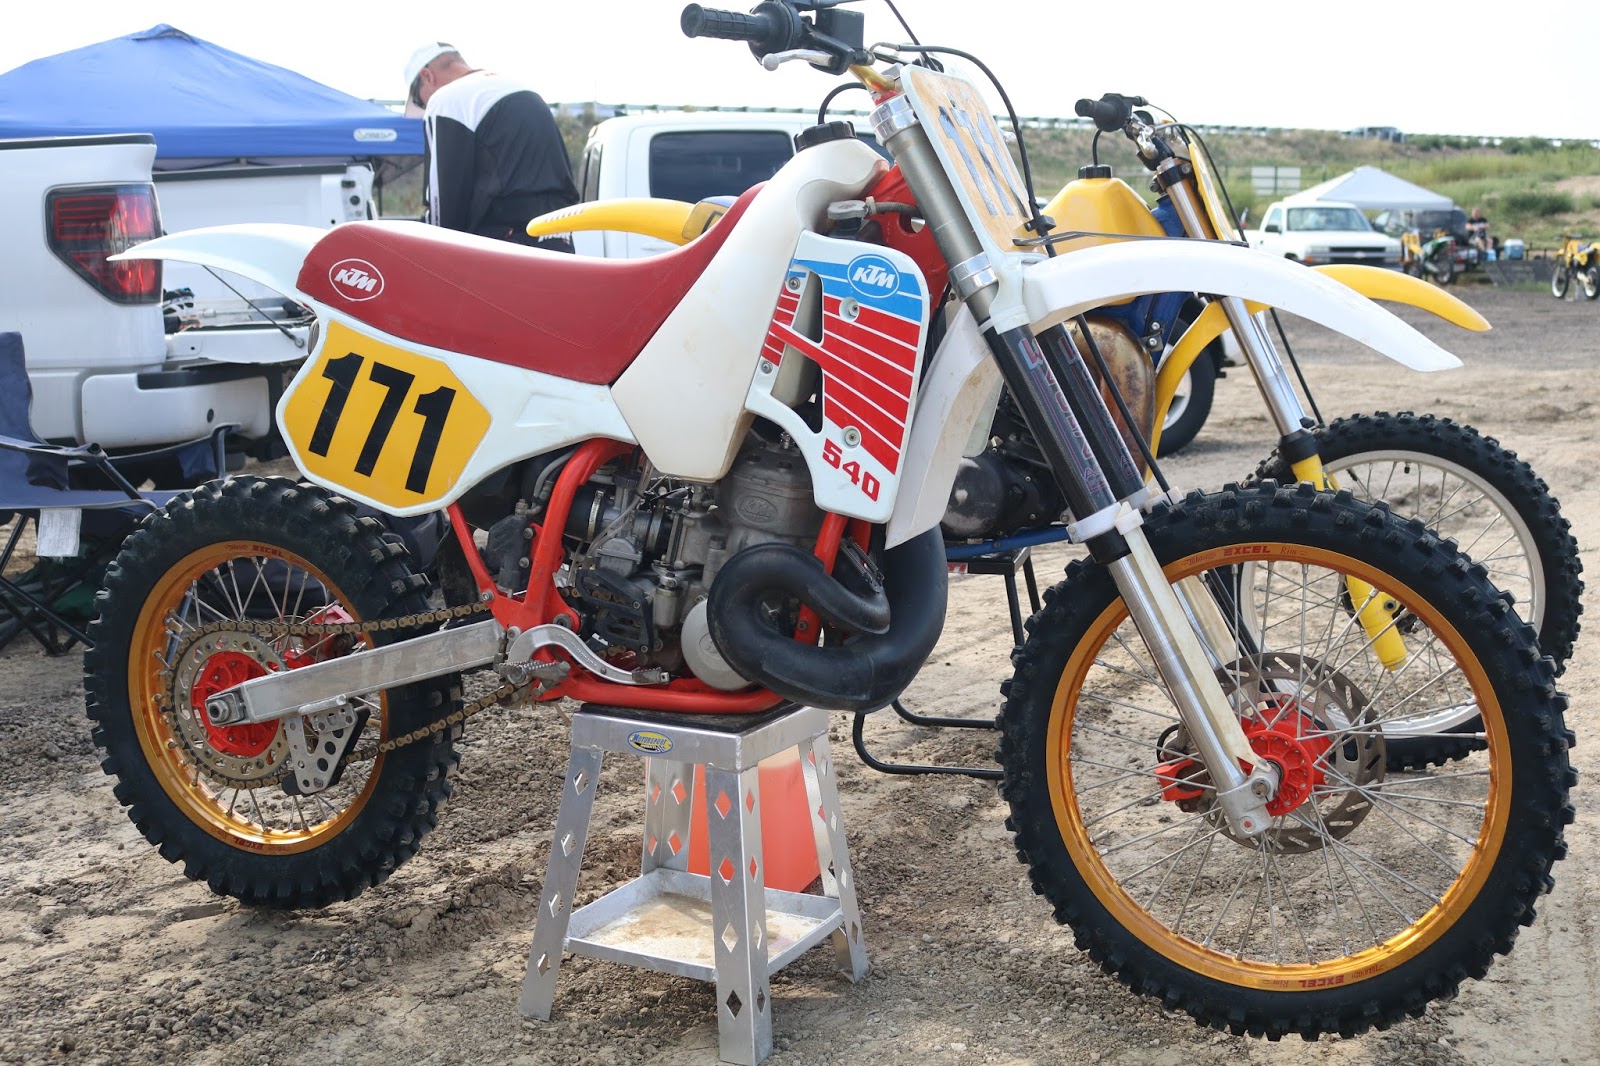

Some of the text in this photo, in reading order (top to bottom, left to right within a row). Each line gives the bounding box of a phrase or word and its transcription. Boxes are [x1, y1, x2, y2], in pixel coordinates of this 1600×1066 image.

[334, 268, 378, 292] KTM
[852, 264, 896, 289] KTM
[308, 352, 457, 495] 171
[822, 437, 881, 503] 540
[1223, 545, 1271, 557] EXCEL
[1298, 975, 1344, 988] EXCEL
